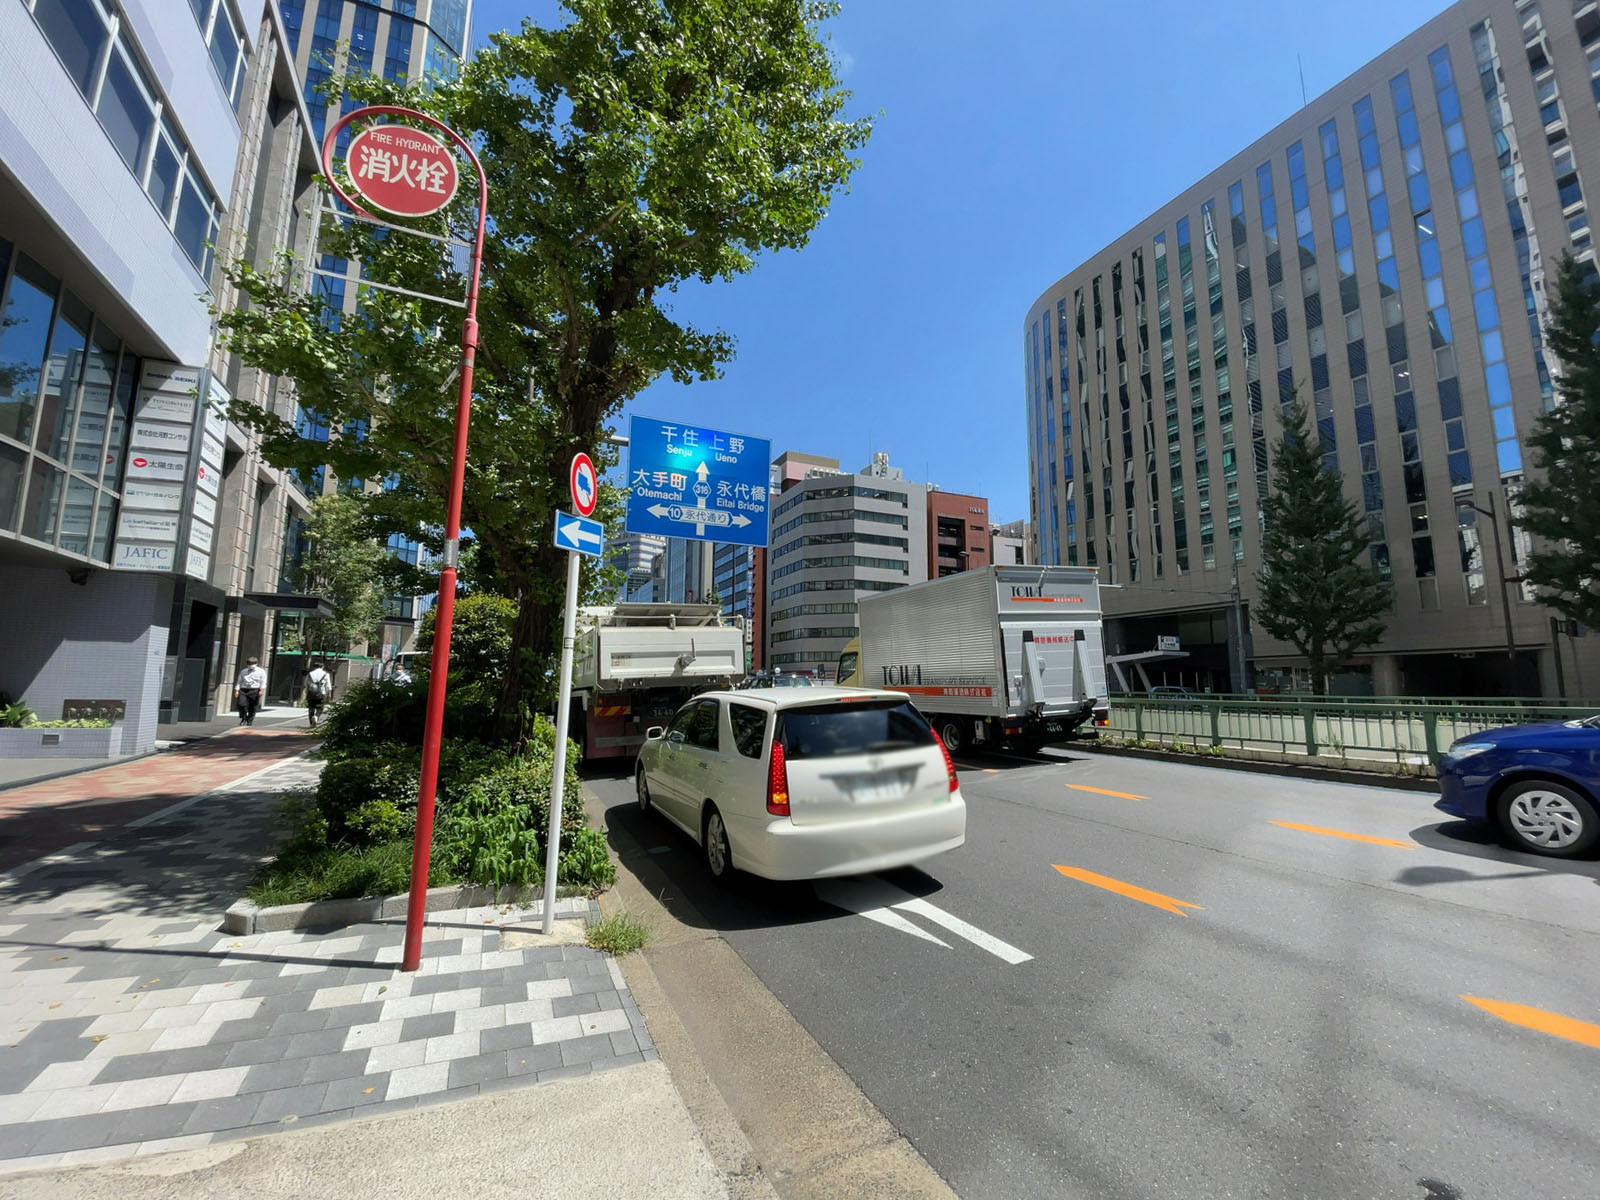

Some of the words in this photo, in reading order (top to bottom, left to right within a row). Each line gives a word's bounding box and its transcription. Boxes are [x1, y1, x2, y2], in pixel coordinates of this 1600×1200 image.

[370, 132, 392, 146] FIRE
[395, 137, 440, 155] HYDRANT
[358, 145, 449, 194] 消火栓
[661, 425, 699, 447] 千住
[709, 434, 744, 454] 上野
[666, 444, 693, 457] Senju
[715, 452, 738, 464] Ueno
[148, 460, 184, 472] 太陽生命
[632, 468, 688, 491] 大手町
[717, 480, 766, 503] 永代橋
[695, 485, 709, 495] 316
[637, 486, 683, 502] Otemachi
[669, 507, 681, 519] 10
[716, 497, 735, 509] Eitai
[738, 500, 765, 513] Bridge
[685, 510, 727, 523] 永代通り
[123, 546, 168, 560] JAFIC
[882, 664, 922, 686] TOWA
